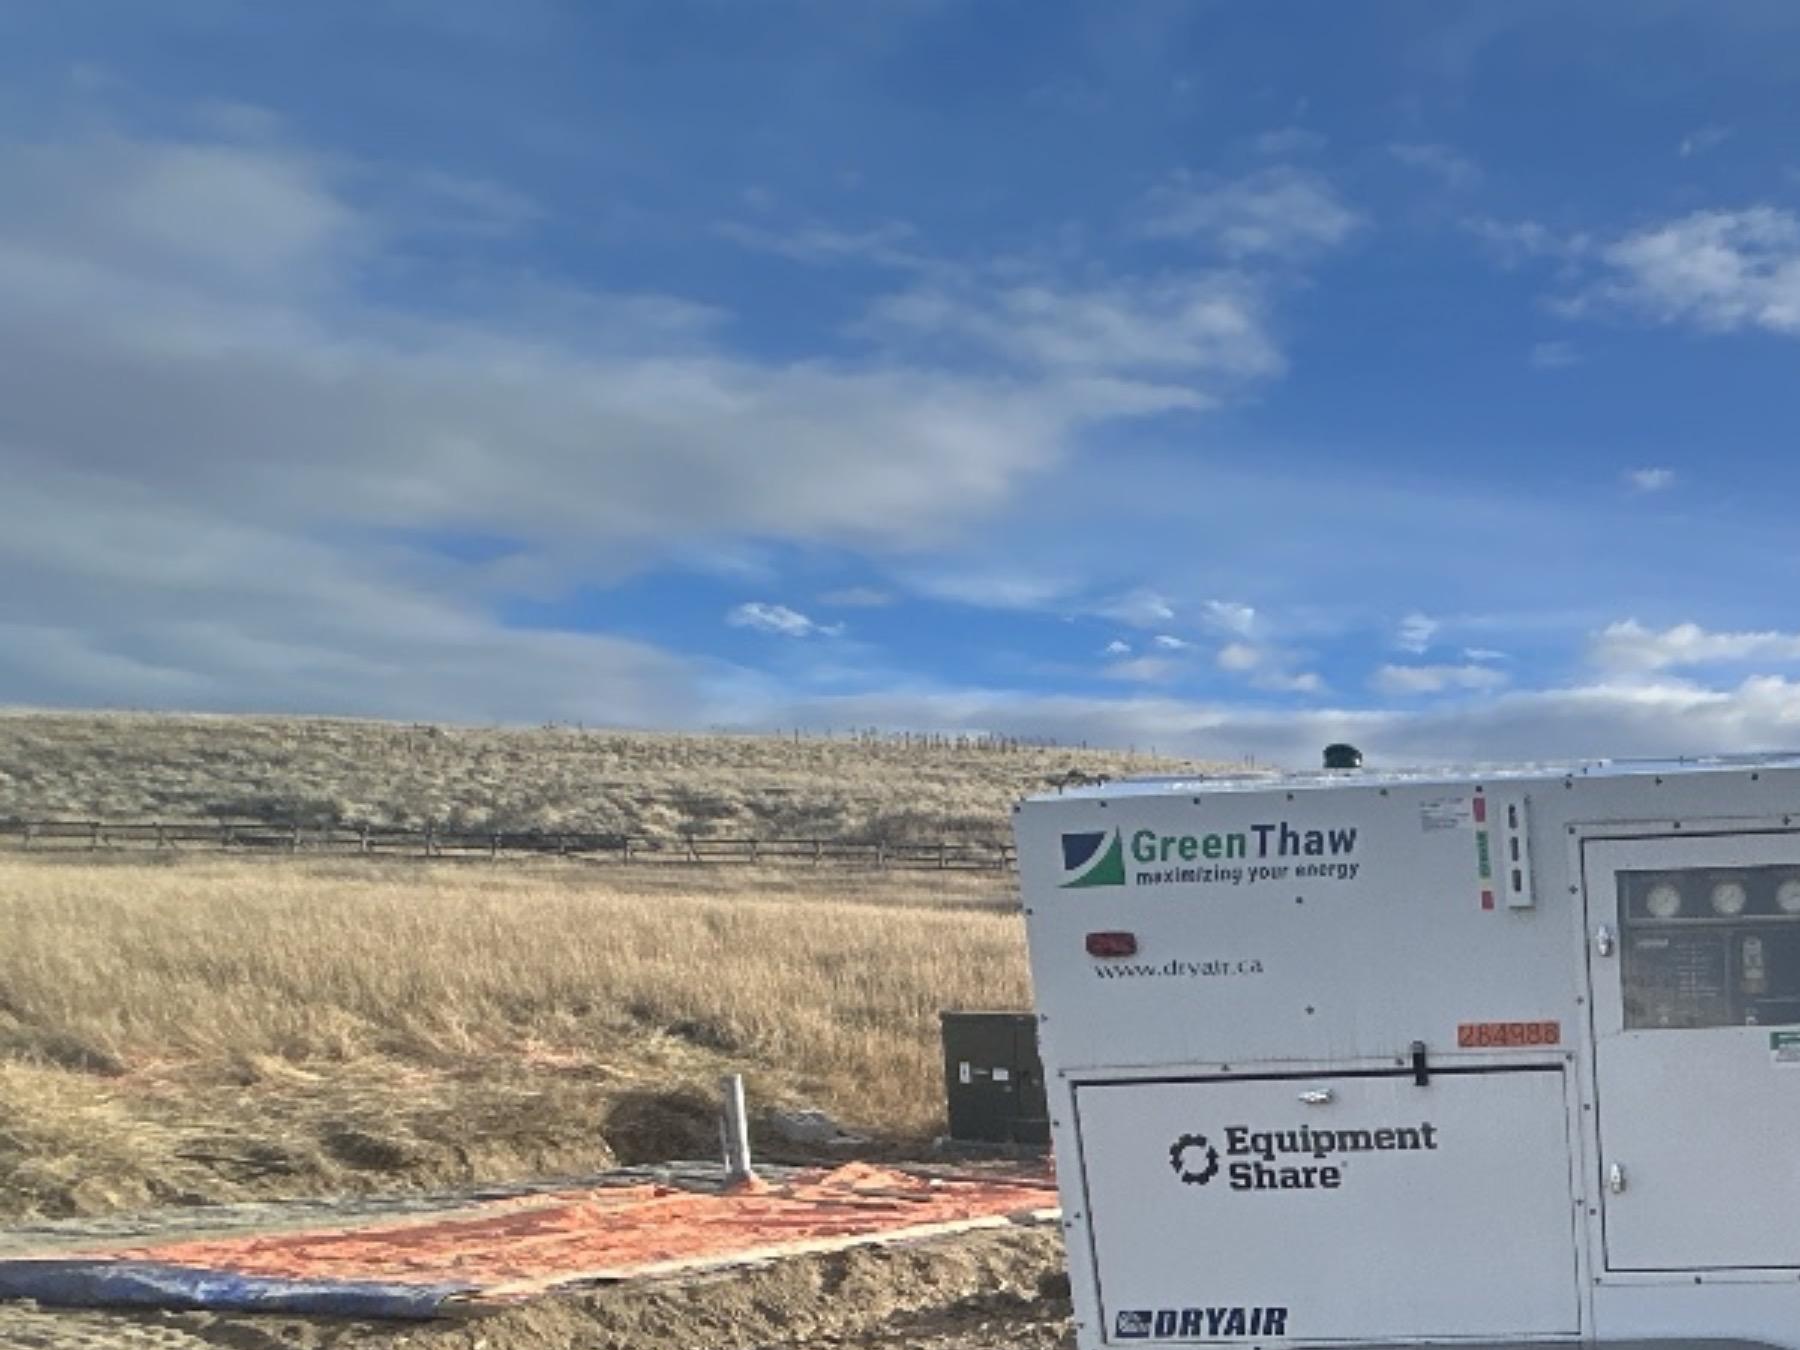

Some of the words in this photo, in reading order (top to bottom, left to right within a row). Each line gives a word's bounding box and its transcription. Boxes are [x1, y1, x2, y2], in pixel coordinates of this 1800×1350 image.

[1136, 864, 1243, 886] maximizing
[1248, 865, 1289, 884] your
[1295, 862, 1360, 881] energy
[1094, 958, 1264, 979] www.dryair.ca
[1224, 1121, 1438, 1161] Equipment
[1228, 1161, 1342, 1191] Share
[1155, 1307, 1288, 1338] DRYAIR
